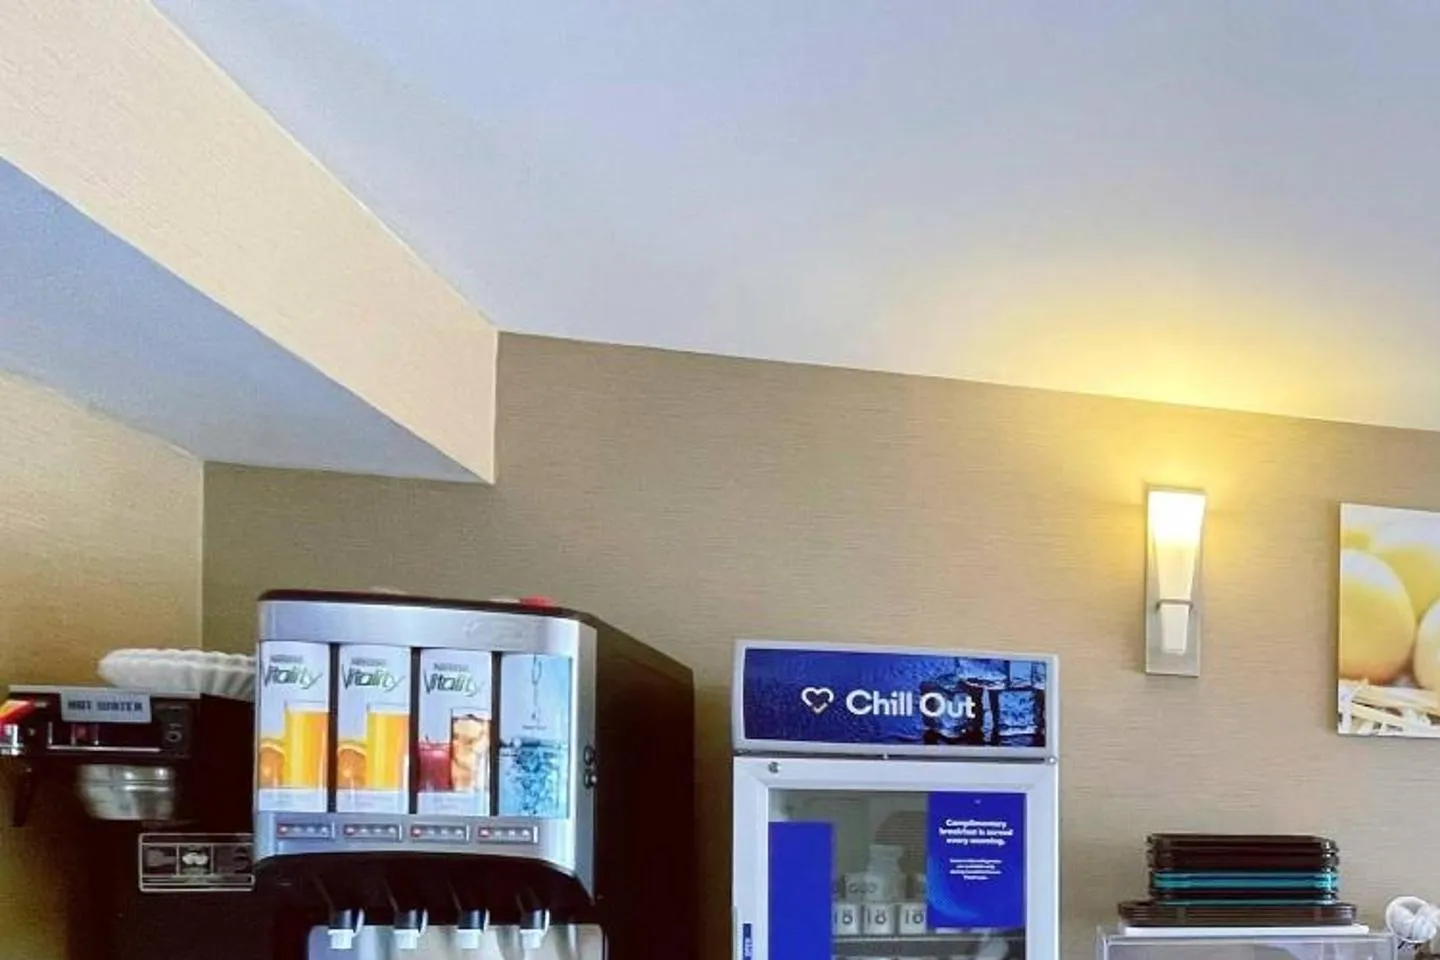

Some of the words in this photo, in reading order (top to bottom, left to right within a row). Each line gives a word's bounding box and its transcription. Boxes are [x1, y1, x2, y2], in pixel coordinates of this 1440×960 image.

[342, 664, 406, 692] Vitality
[424, 669, 487, 698] Vitality
[846, 689, 913, 716] Chill
[919, 692, 976, 718] Out
